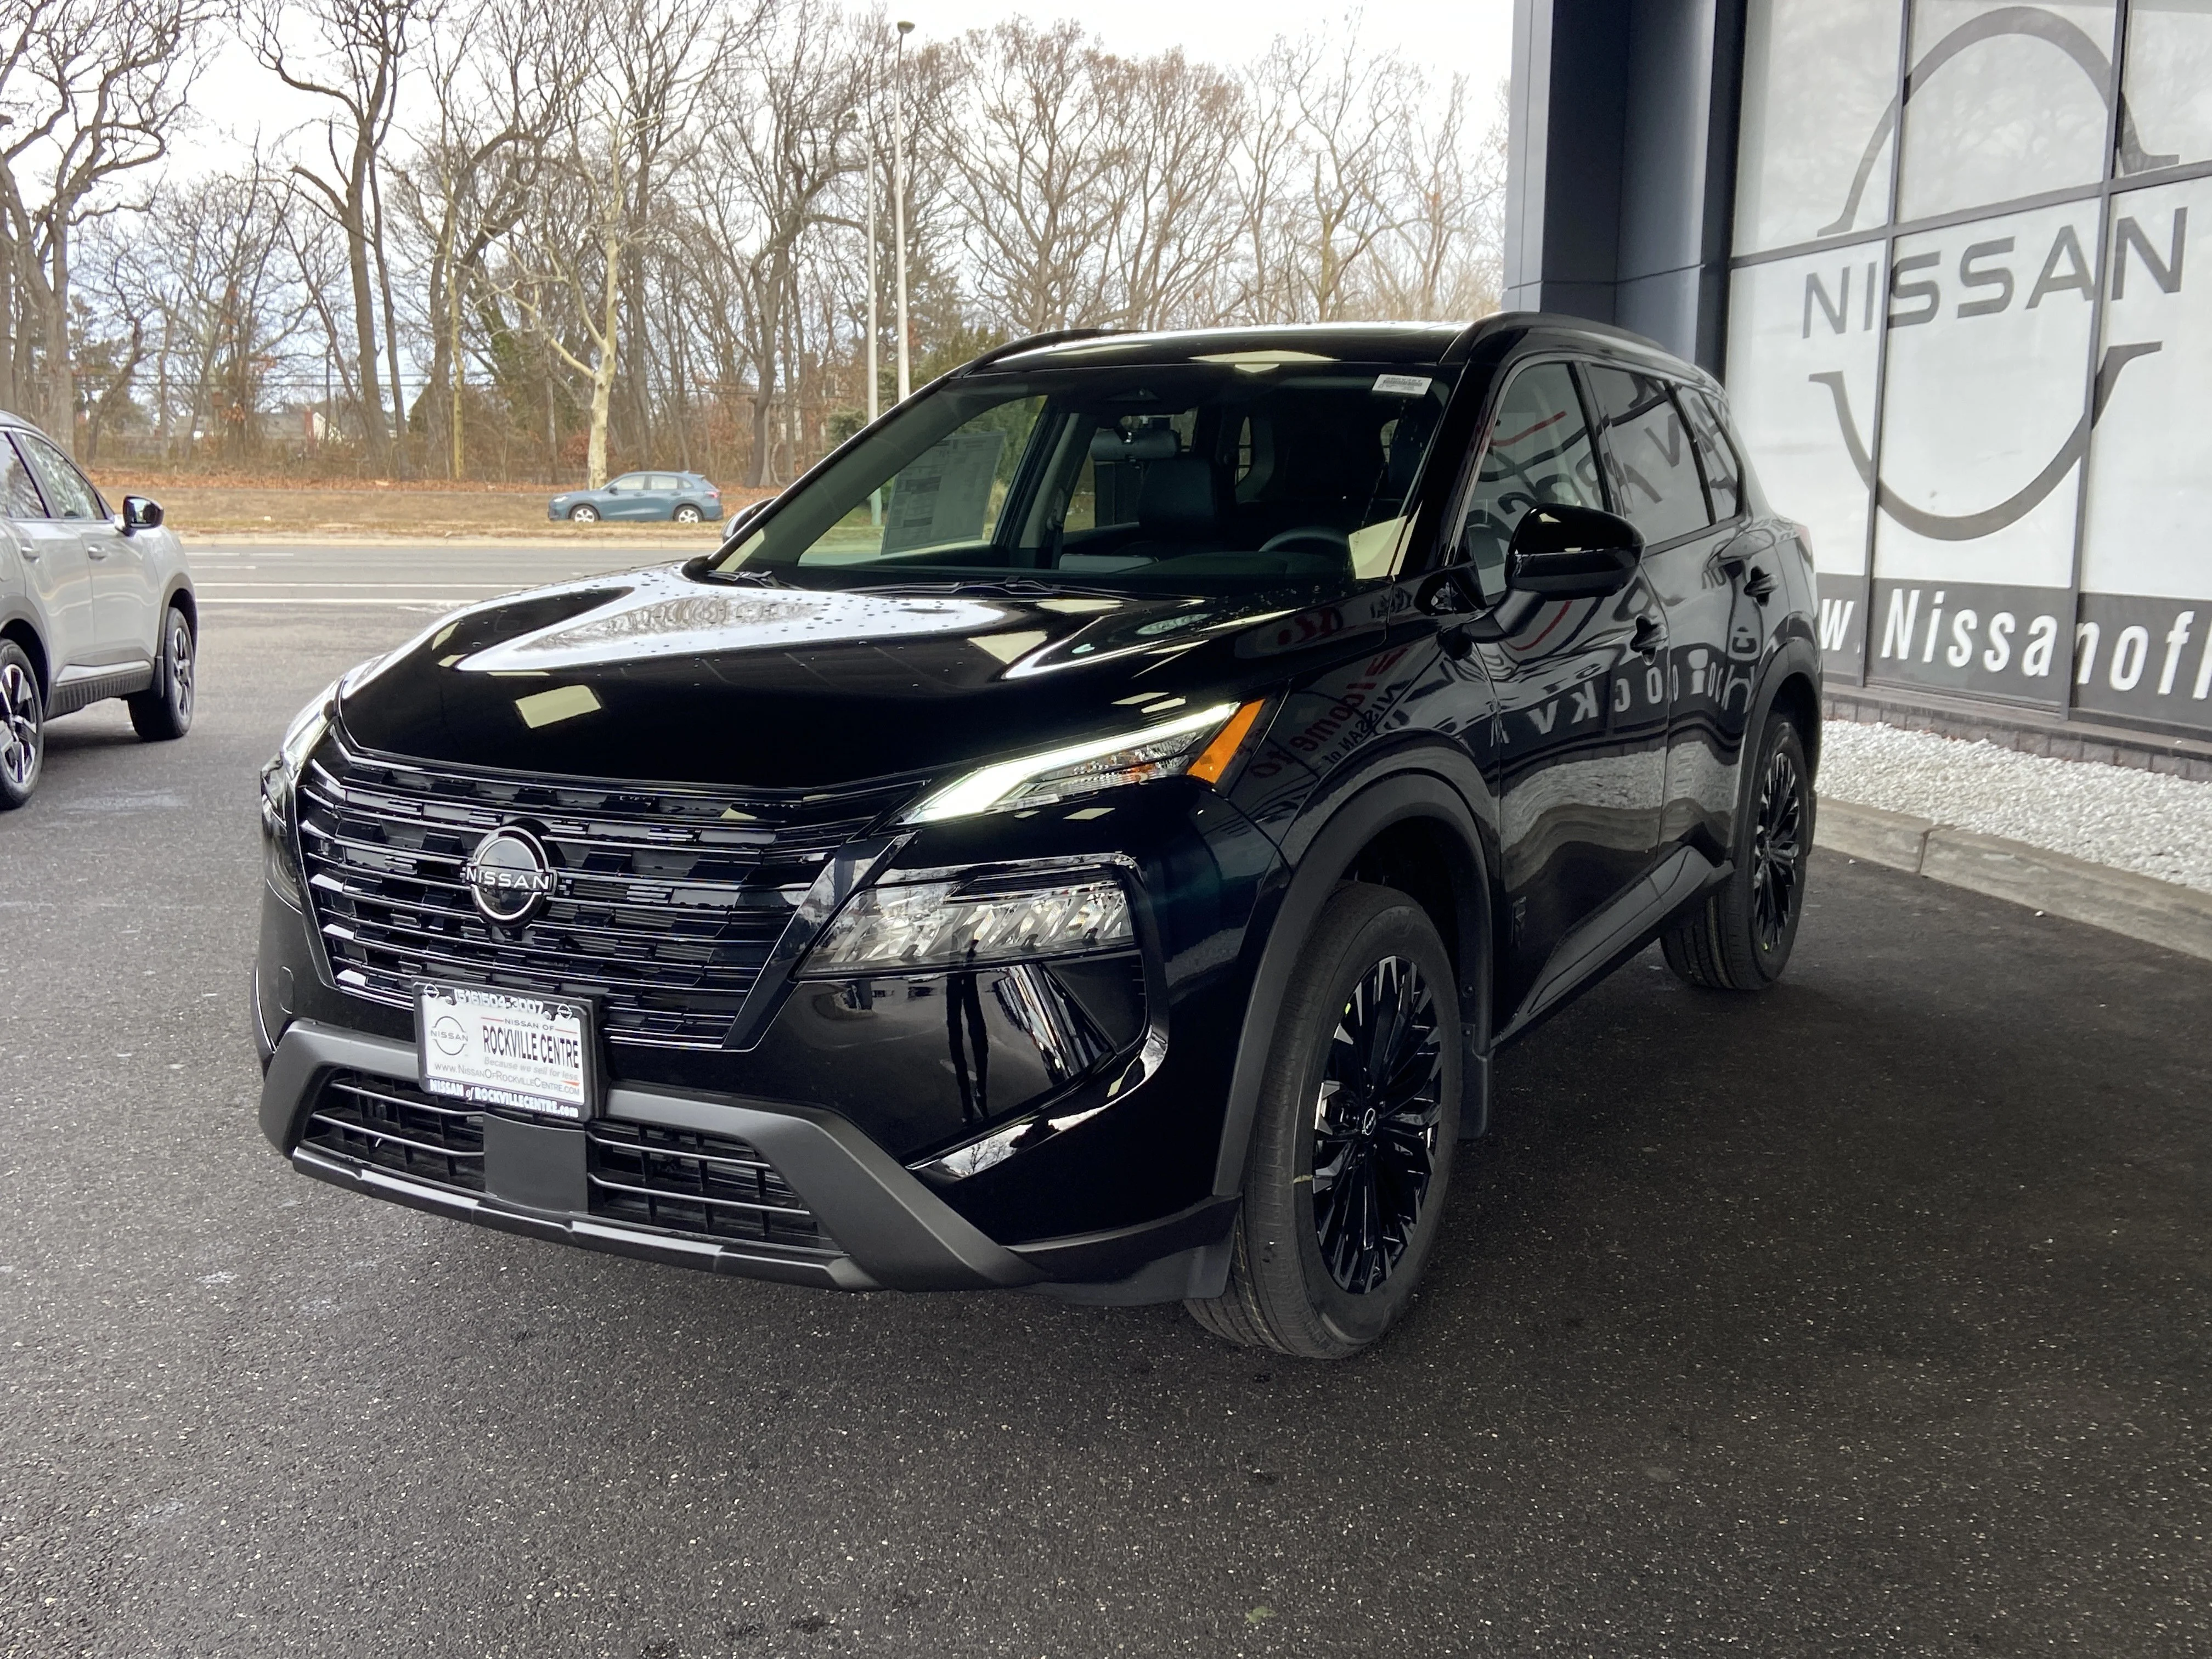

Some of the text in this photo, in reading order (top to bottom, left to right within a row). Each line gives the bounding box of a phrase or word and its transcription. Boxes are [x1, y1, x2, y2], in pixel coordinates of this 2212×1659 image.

[1802, 207, 2188, 339] NISSAN
[466, 867, 549, 890] NISSAN
[504, 1018, 539, 1029] NISSAN
[430, 1030, 469, 1042] NISSAN
[482, 1025, 580, 1069] ROCKVILLE CENTRE
[484, 1057, 518, 1070] Because
[520, 1063, 532, 1073] we
[533, 1065, 548, 1075] sell
[549, 1068, 561, 1078] for
[430, 1079, 464, 1097] NISSAN
[466, 1086, 476, 1101] of
